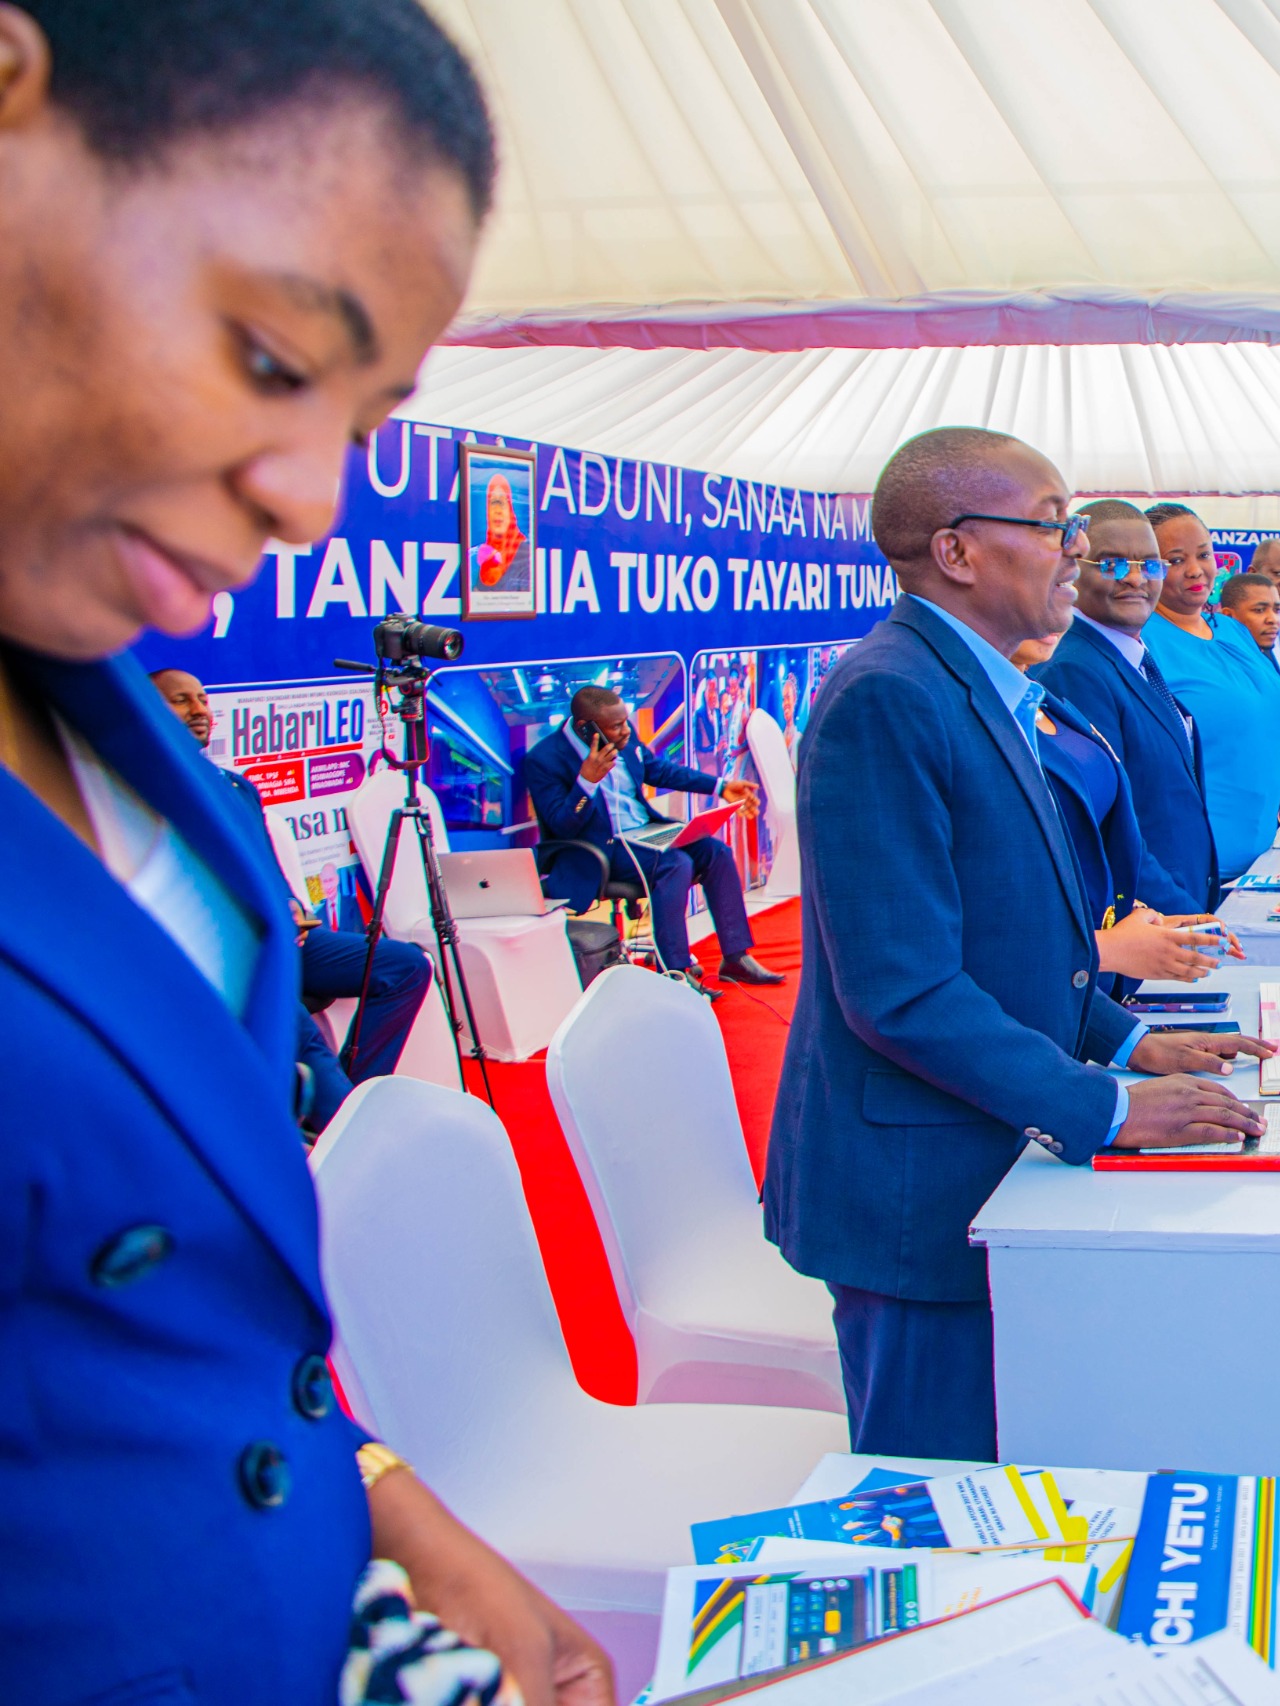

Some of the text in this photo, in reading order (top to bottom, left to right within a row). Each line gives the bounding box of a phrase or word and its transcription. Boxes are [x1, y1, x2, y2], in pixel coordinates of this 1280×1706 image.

[367, 422, 877, 542] UTADUNI, SANAA NA M
[261, 535, 601, 618] TANZIA
[610, 551, 719, 613] TUKO
[727, 557, 830, 611] TAYARI
[1150, 1482, 1210, 1646] CHI YETU
